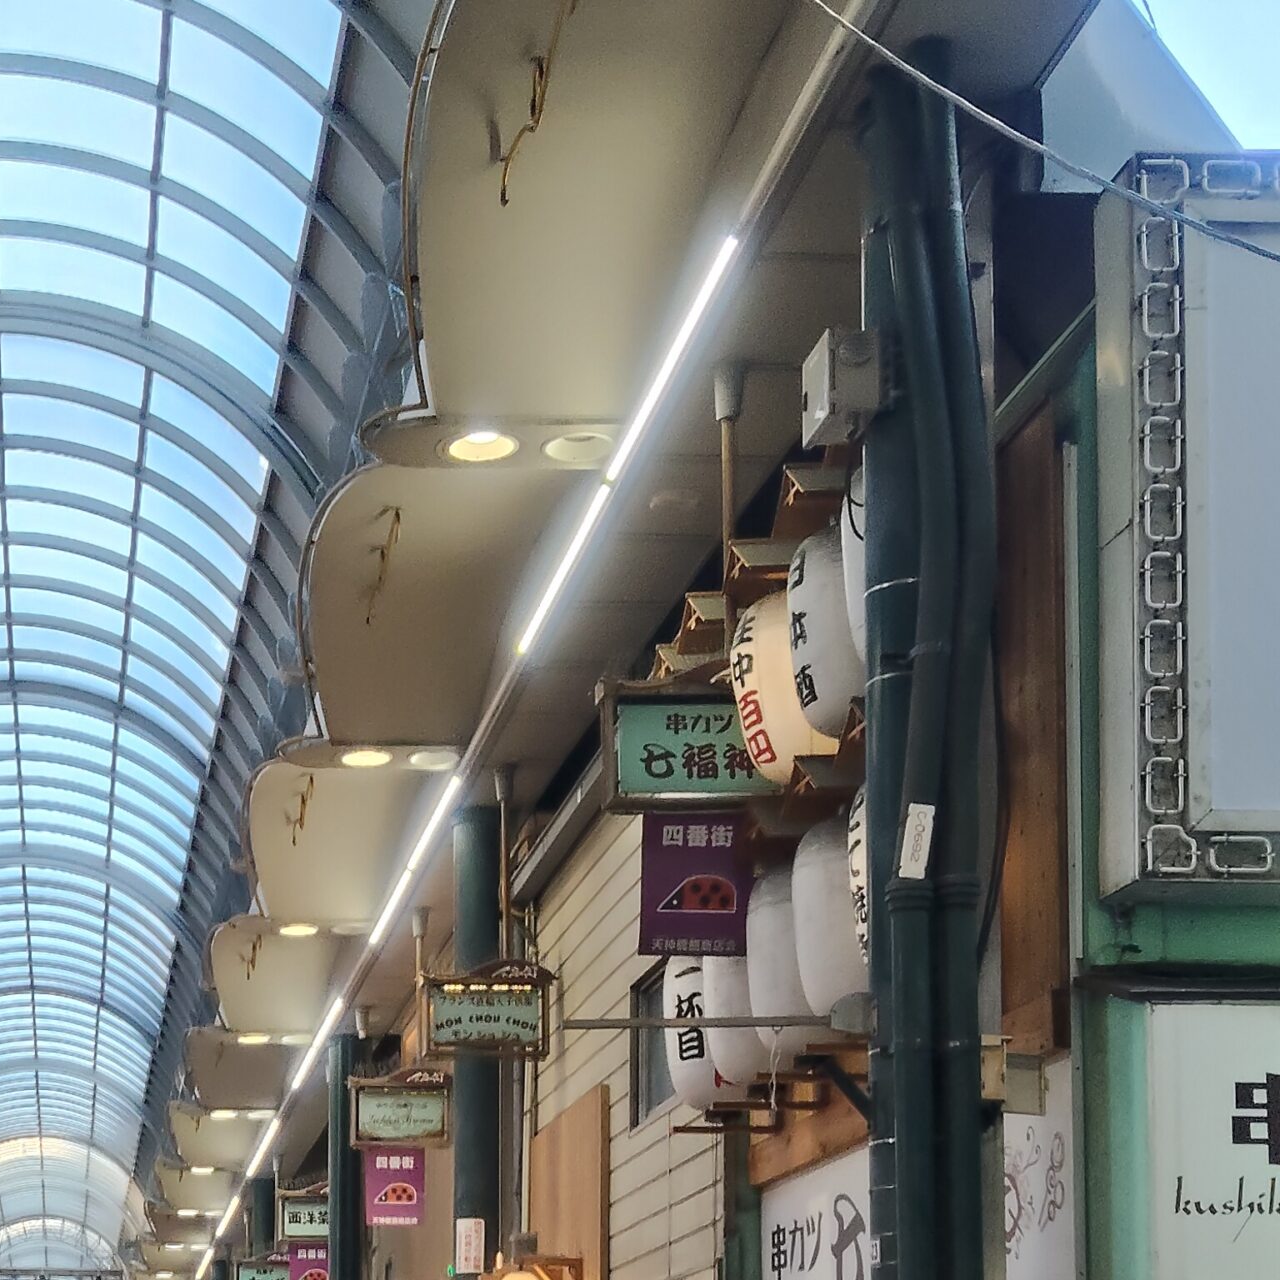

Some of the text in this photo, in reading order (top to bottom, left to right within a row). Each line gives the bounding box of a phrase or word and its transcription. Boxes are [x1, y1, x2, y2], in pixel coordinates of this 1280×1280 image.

[666, 713, 733, 735] 串カツ
[640, 743, 755, 780] 七福神
[662, 824, 734, 848] 四番街
